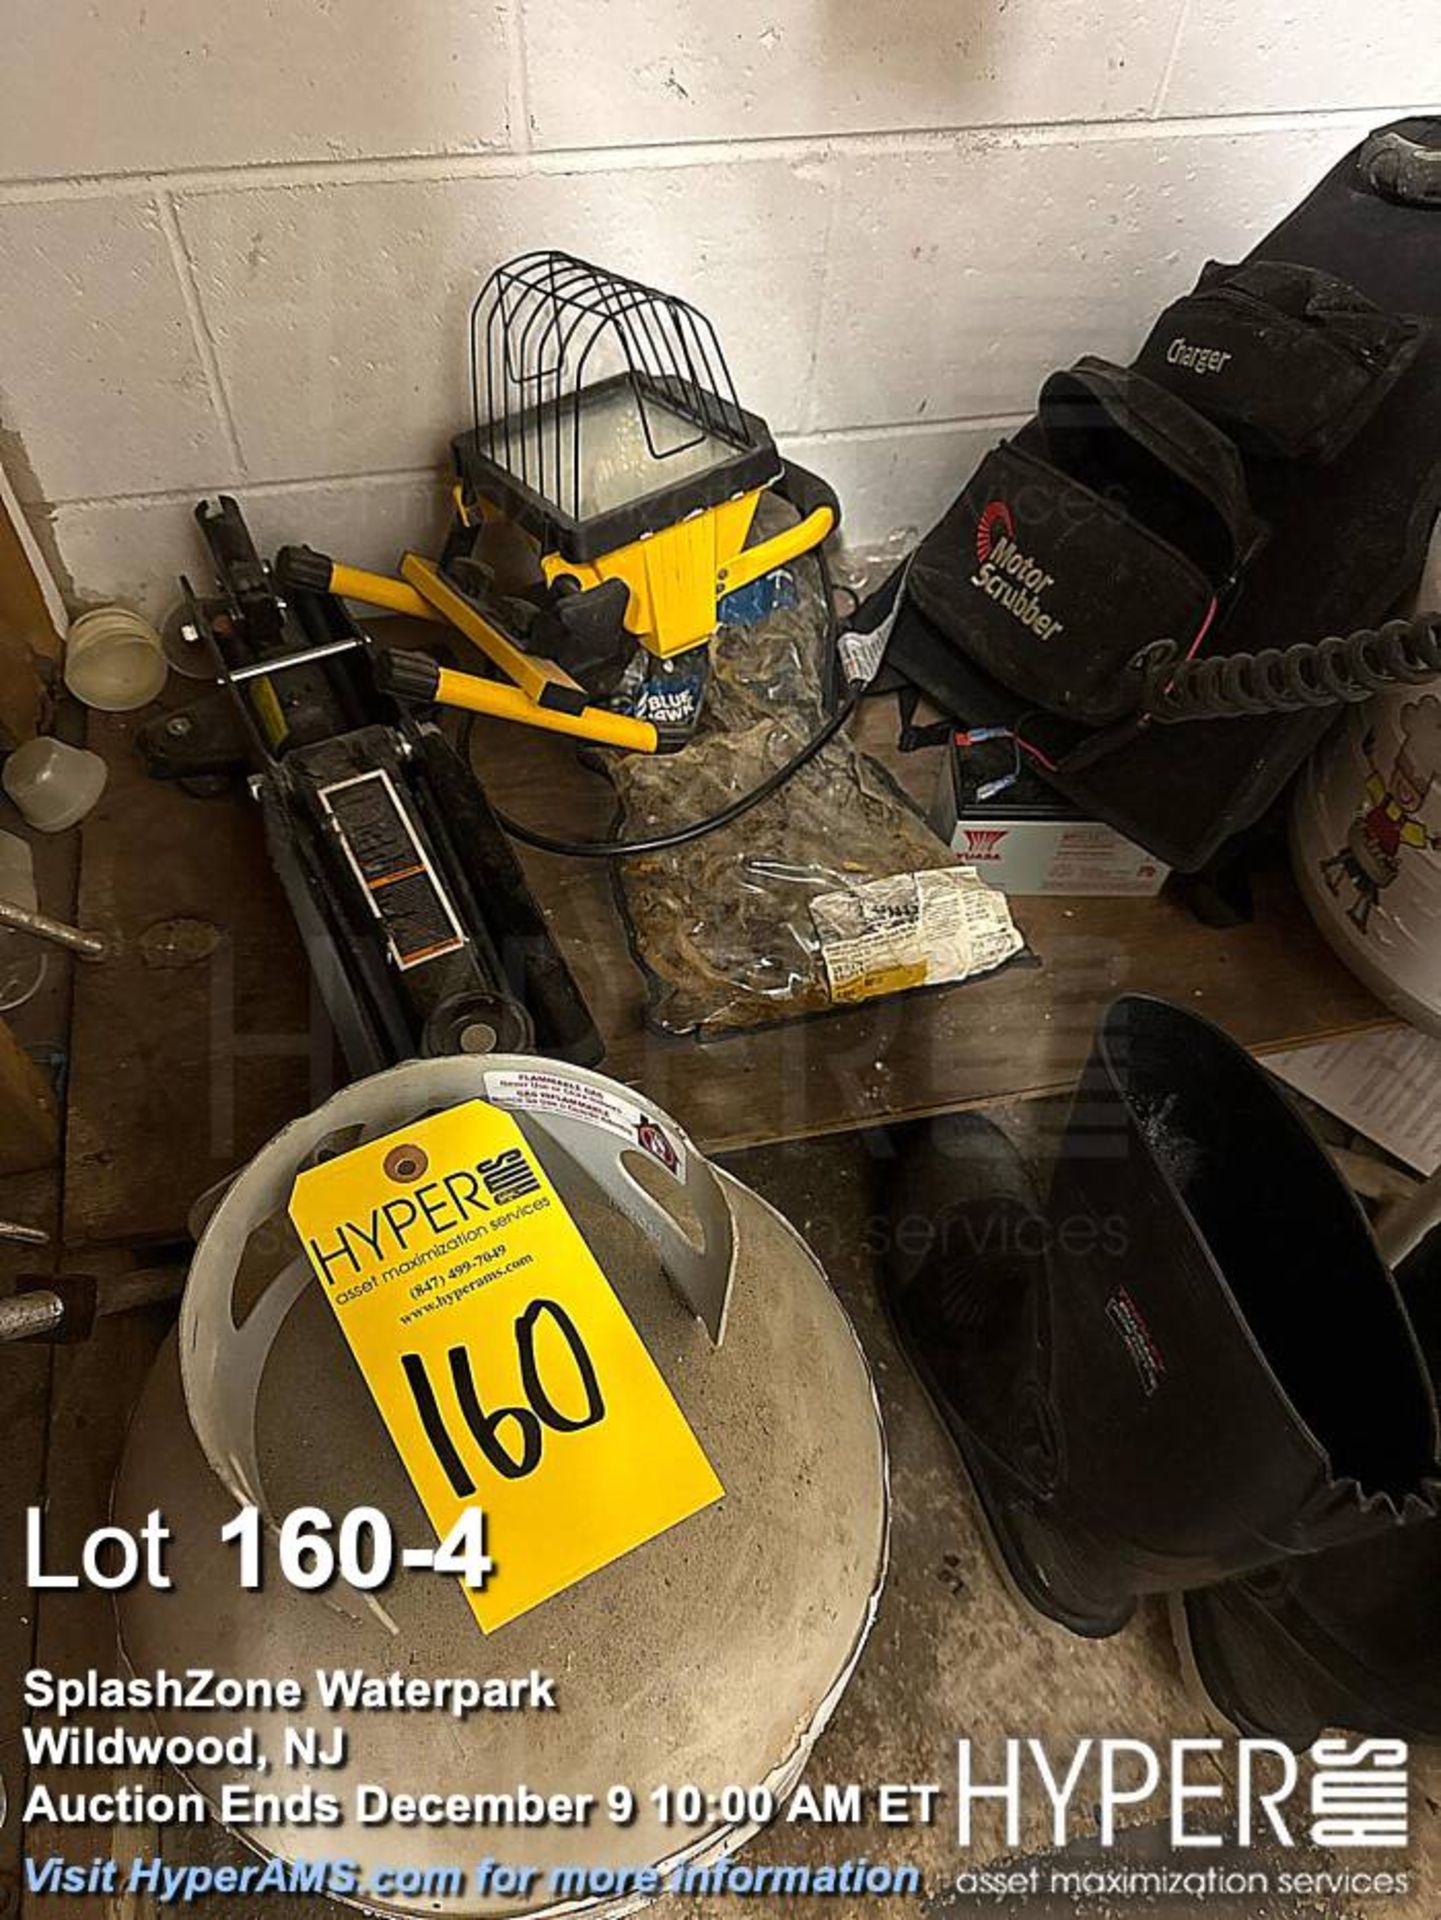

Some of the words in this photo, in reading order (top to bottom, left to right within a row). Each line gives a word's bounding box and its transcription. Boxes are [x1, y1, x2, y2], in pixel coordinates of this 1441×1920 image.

[1166, 337, 1233, 374] Charger
[970, 563, 1063, 641] Scrubber
[989, 536, 1055, 596] Motor
[309, 1173, 486, 1287] HYPER
[334, 1279, 378, 1307] asset
[382, 1226, 487, 1287] maximization
[489, 1195, 552, 1233] services
[399, 1251, 535, 1328] www.hyperams.com
[409, 1273, 448, 1302] (847)
[447, 1243, 508, 1282] 499-7049
[401, 1298, 606, 1499] 160
